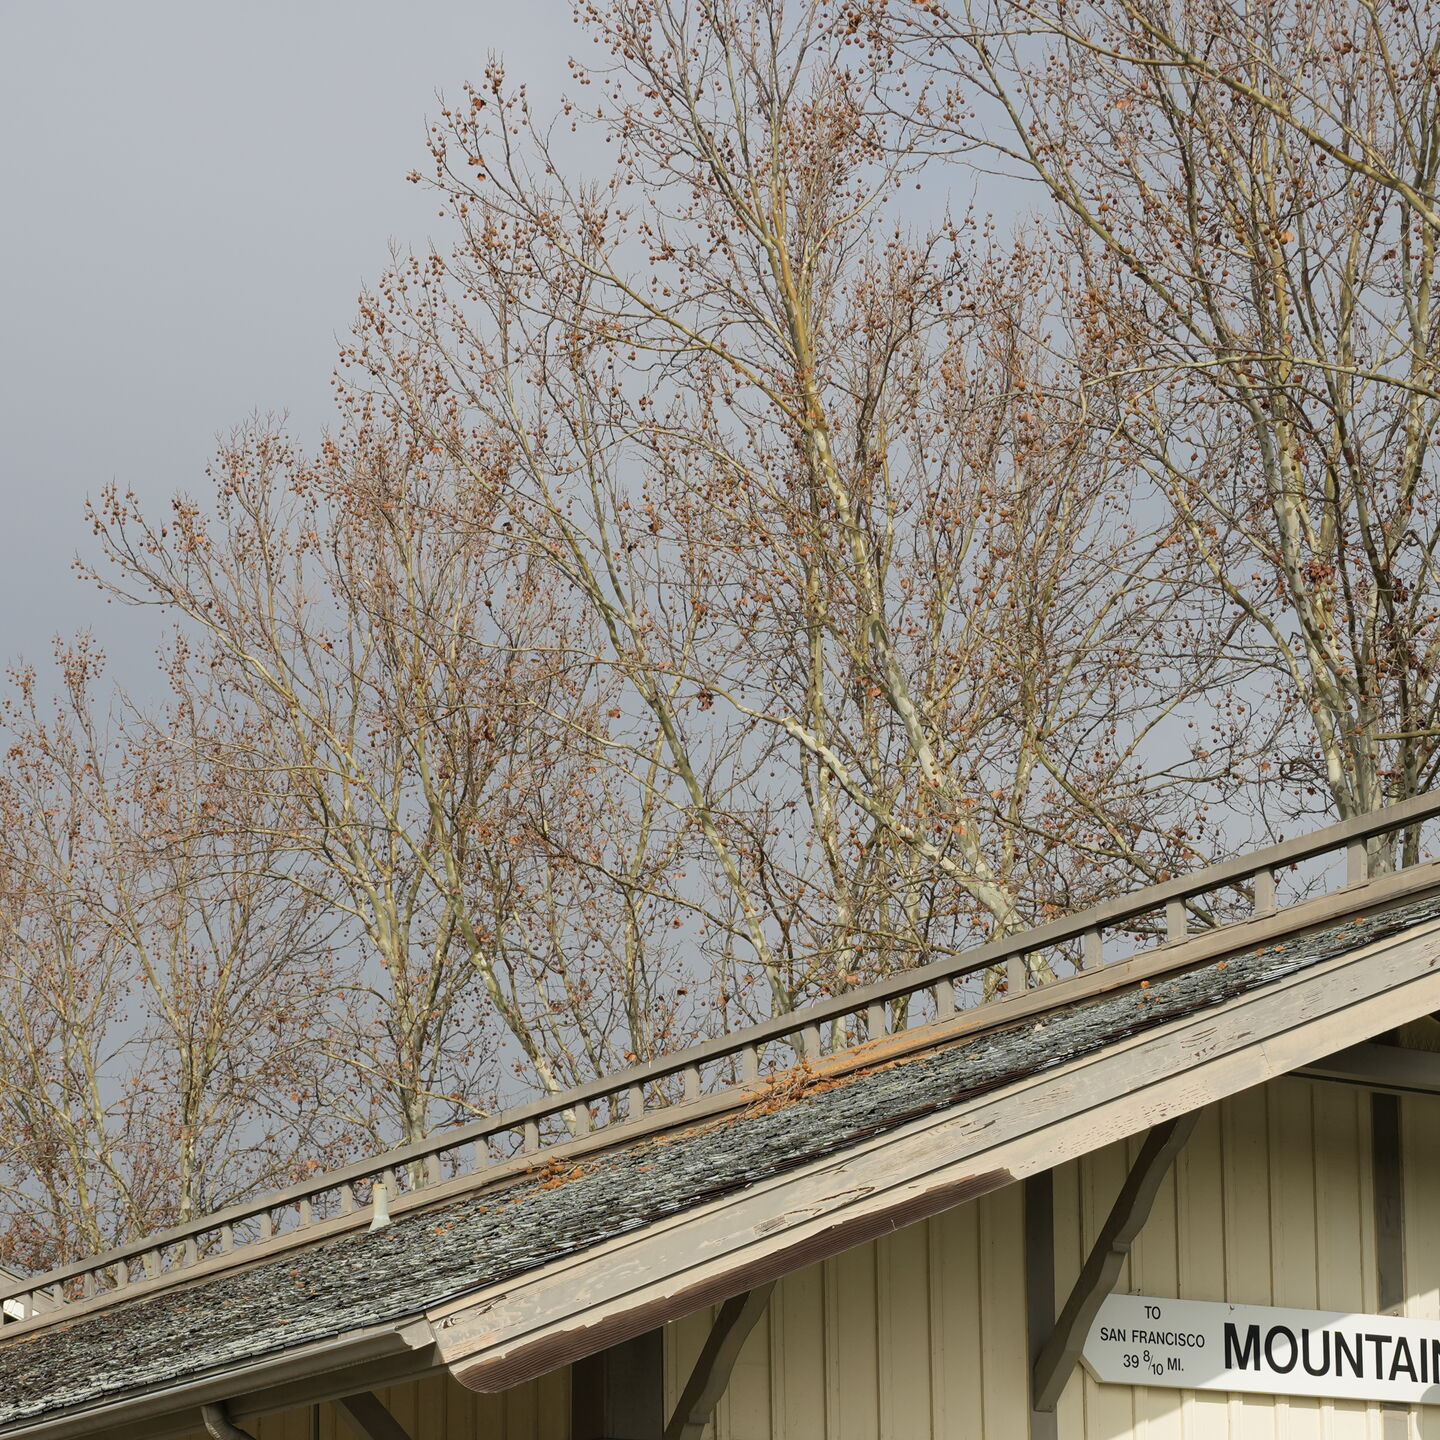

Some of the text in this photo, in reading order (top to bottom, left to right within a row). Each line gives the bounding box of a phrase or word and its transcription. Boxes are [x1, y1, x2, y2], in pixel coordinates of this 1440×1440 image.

[1144, 1305, 1161, 1320] TO
[1100, 1327, 1205, 1348] SAN FRANCISCO
[1123, 1354, 1140, 1368] 39
[1167, 1357, 1184, 1371] MI.
